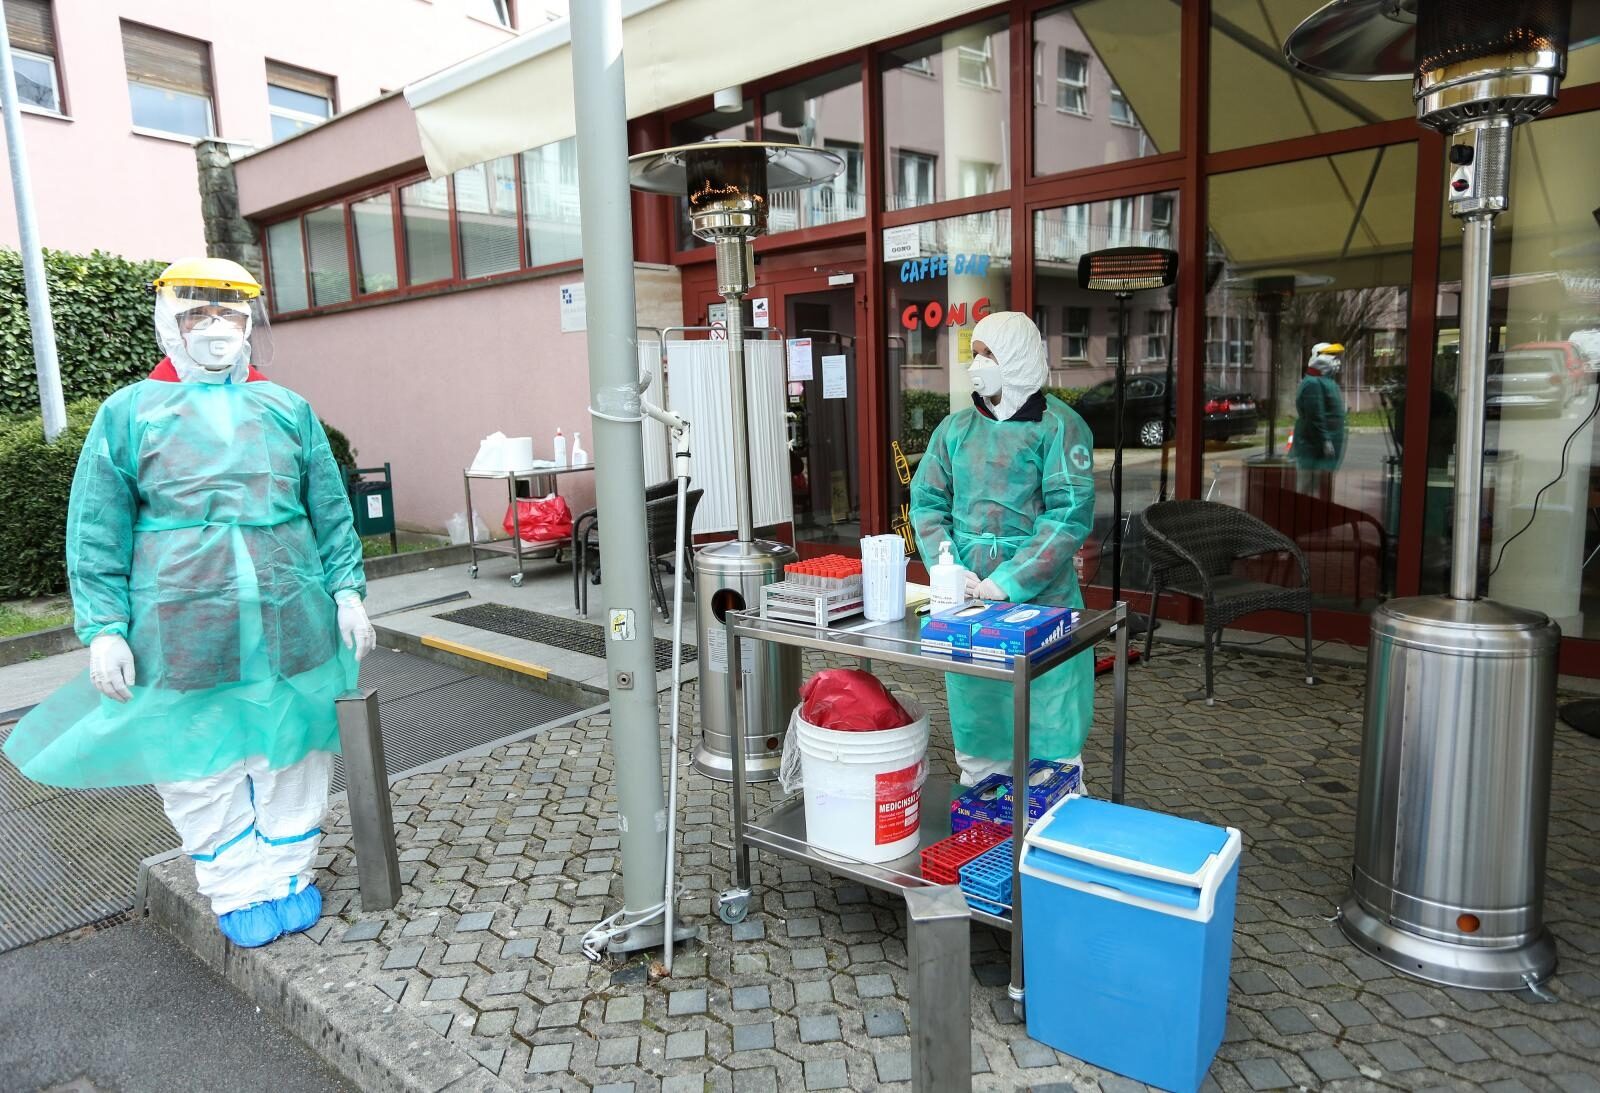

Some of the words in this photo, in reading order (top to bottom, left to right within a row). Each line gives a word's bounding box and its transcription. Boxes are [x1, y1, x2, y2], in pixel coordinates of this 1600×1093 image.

[900, 256, 948, 283] CAFFE
[954, 253, 991, 278] BAR
[901, 297, 991, 331] GONG
[879, 793, 916, 813] MEDICINSKI
